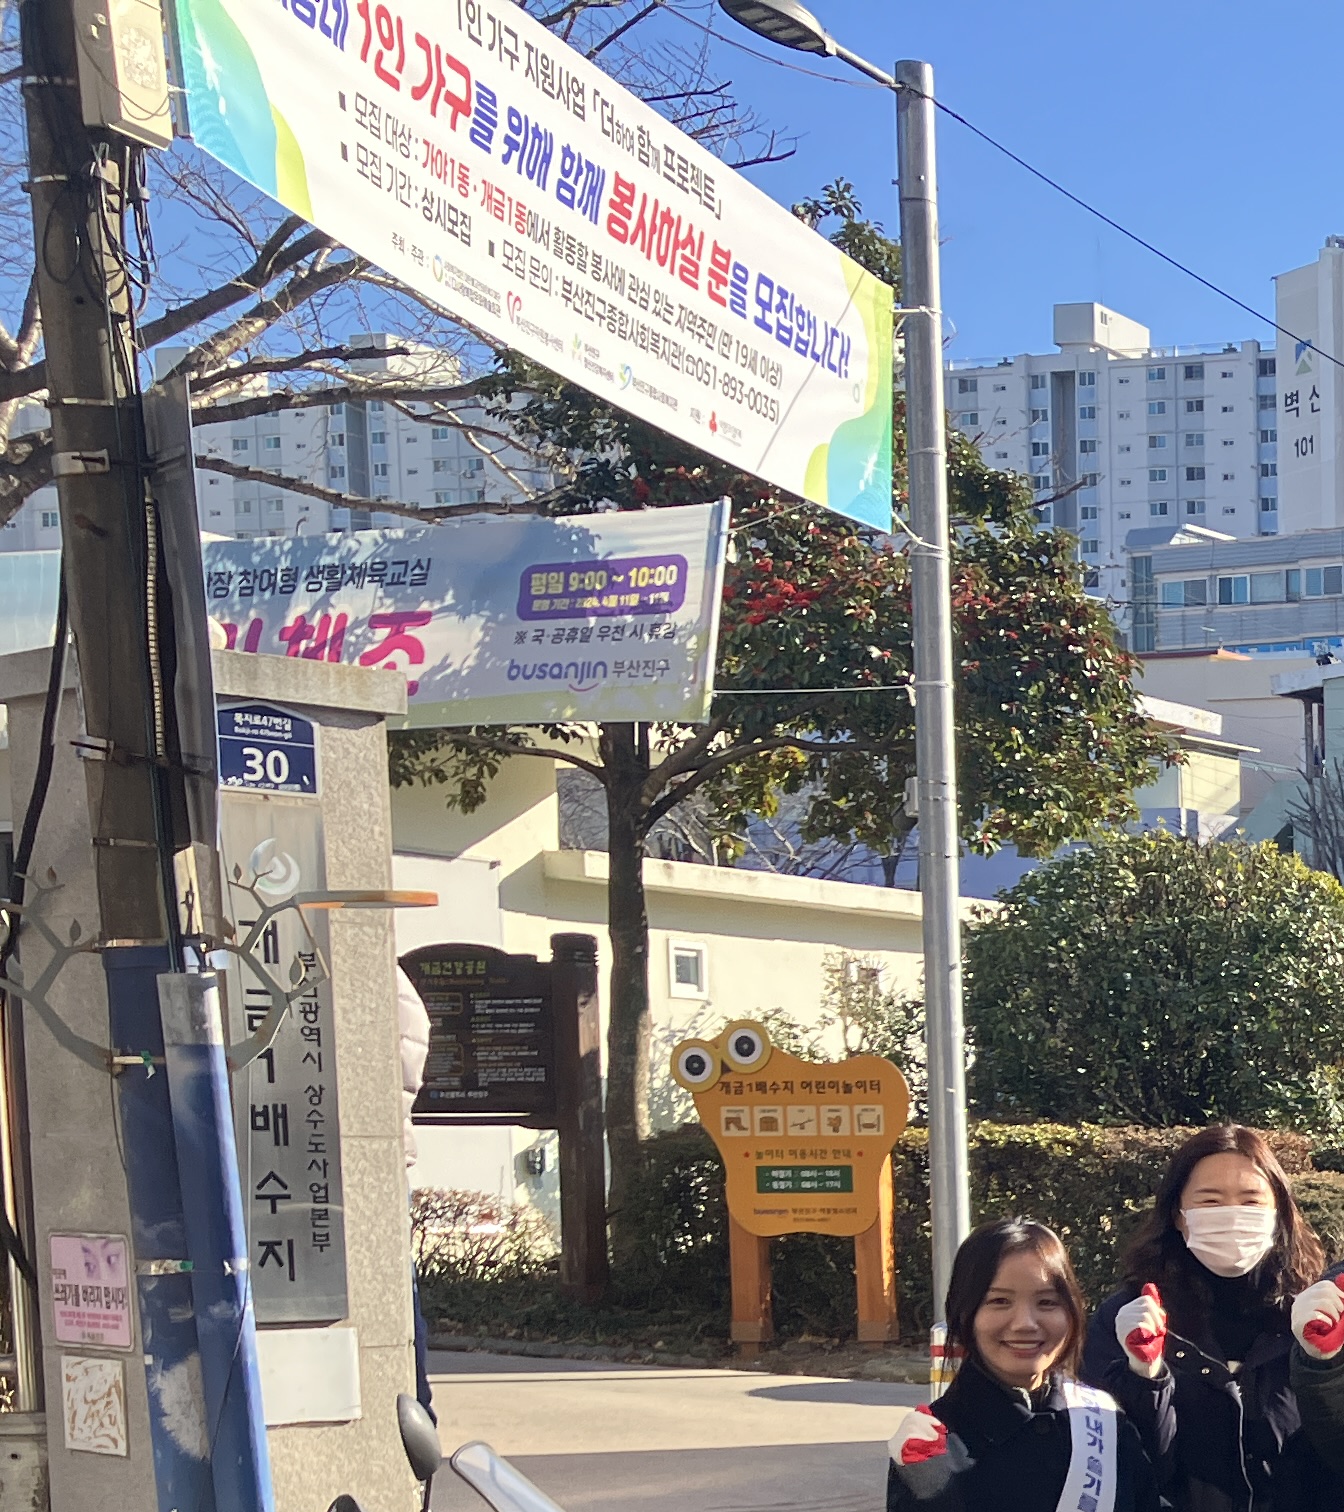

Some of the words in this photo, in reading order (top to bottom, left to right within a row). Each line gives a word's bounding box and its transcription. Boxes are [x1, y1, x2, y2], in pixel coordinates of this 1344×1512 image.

[487, 12, 520, 72] 가구
[524, 40, 586, 122] 지원사업
[636, 124, 661, 176] 함께
[357, 0, 406, 92] 1인
[411, 32, 498, 155] 가구를
[501, 105, 554, 192] 위해
[556, 143, 606, 226] 함께
[606, 171, 704, 291] 봉사하실
[707, 240, 749, 320] 분을
[754, 272, 850, 379] 모집합니다!
[355, 91, 381, 140] 모집
[385, 113, 412, 159] 대상
[422, 138, 470, 198] 가야1동
[481, 179, 551, 251] 개금1동에서
[553, 226, 589, 274] 활동할
[590, 250, 625, 296] 봉사에
[628, 273, 651, 311] 관심
[652, 288, 675, 326] 있는
[676, 303, 718, 351] 지역주민
[735, 339, 759, 377] 19세
[356, 141, 382, 189] 모집
[386, 162, 411, 209] 기간
[421, 187, 472, 248] 상시모집
[502, 239, 526, 280] 모집
[528, 255, 553, 297] 문의
[1294, 434, 1314, 458] 101
[238, 566, 299, 597] 참여형
[305, 558, 431, 593] 생활체육교실
[531, 571, 564, 595] 평일
[568, 570, 607, 592] 9:00
[628, 565, 679, 588] 10:00
[596, 624, 626, 642] 우천
[629, 623, 645, 640] 시
[648, 622, 677, 640] 휴강
[507, 659, 608, 685] busanjin
[612, 659, 671, 679] 부산진구
[242, 746, 290, 784] 30
[718, 1080, 795, 1095] 개금1배수지
[800, 1080, 881, 1094] 어린이놀이터
[304, 1083, 330, 1253] 상수도사업본부
